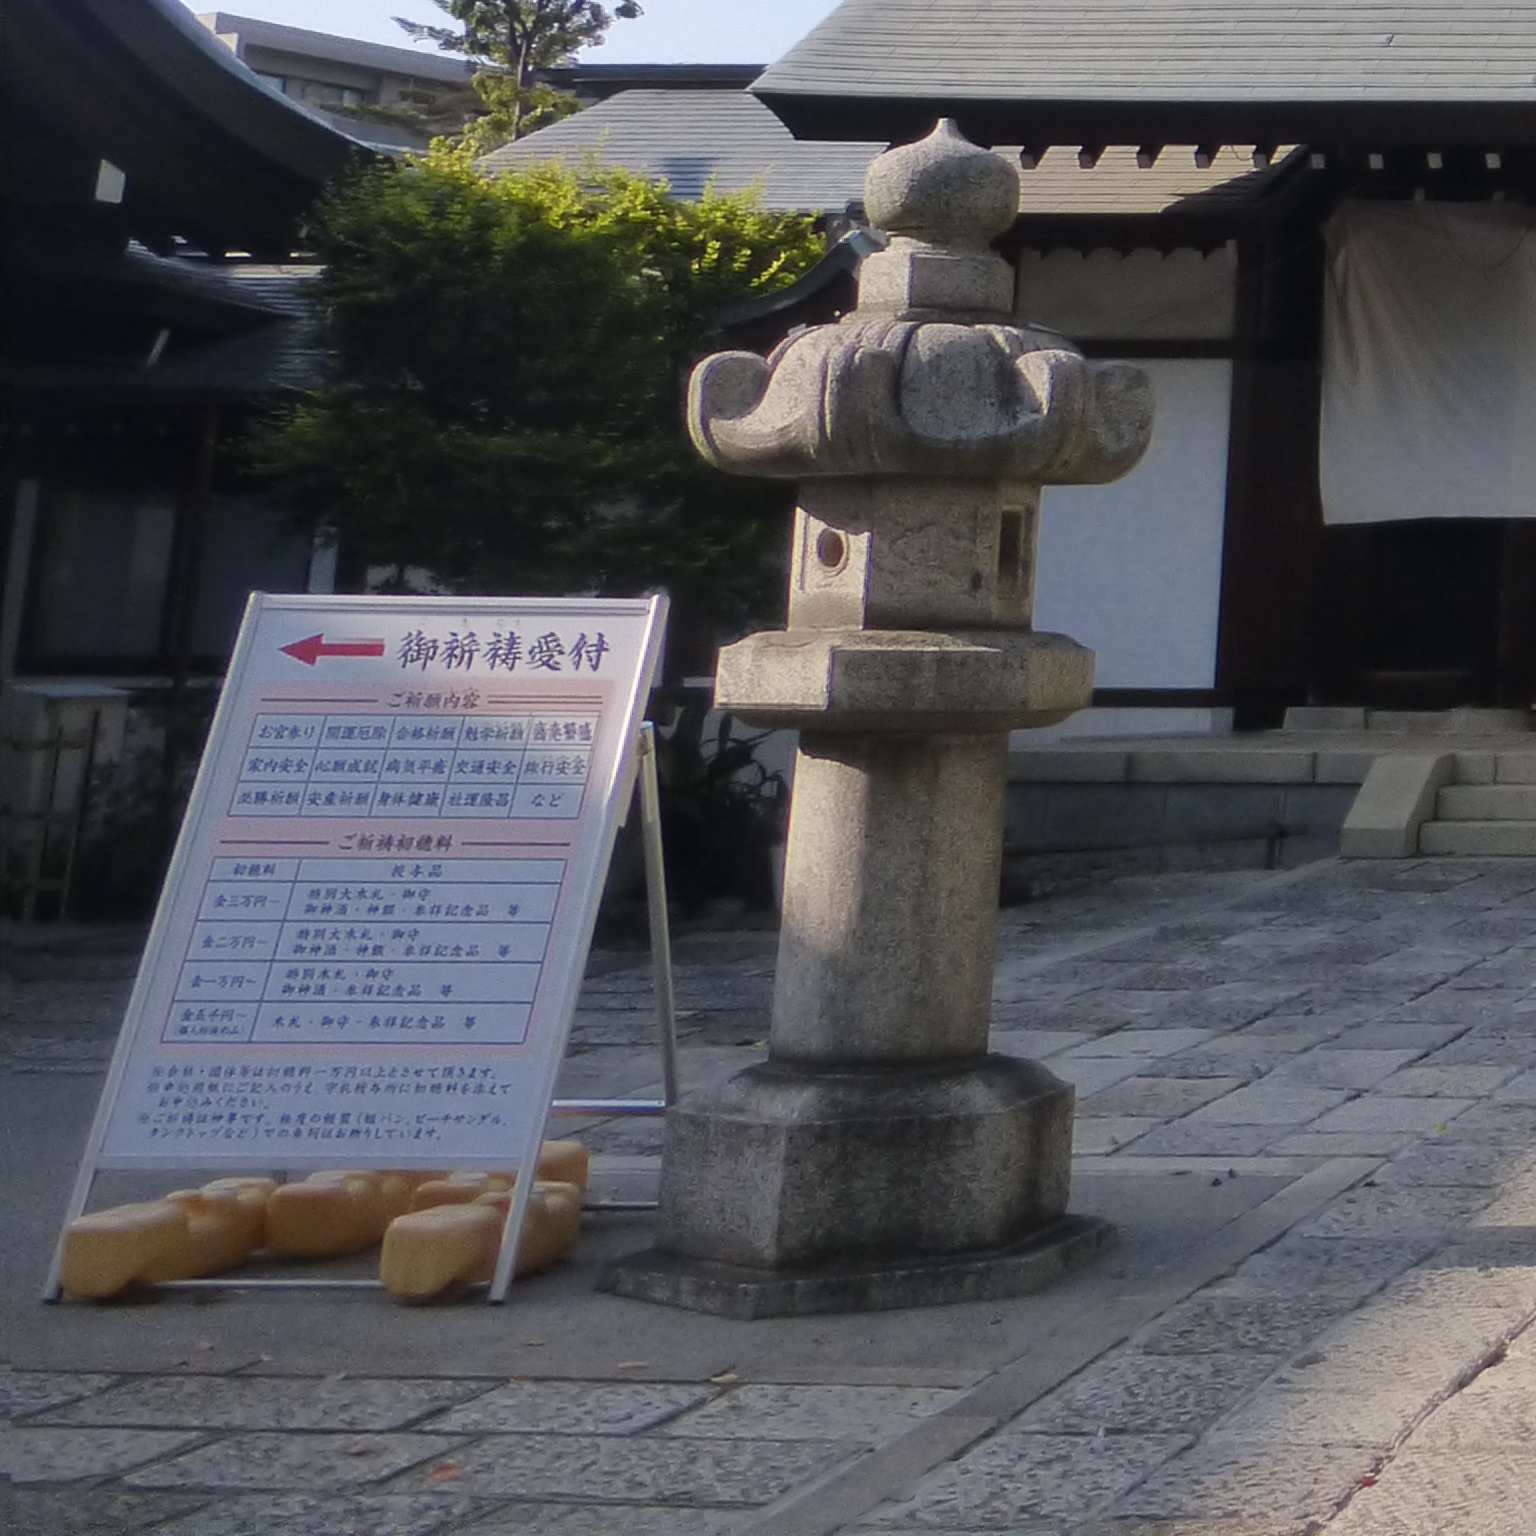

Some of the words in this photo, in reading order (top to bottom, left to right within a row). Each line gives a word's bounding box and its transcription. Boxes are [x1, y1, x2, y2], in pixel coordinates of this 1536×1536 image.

[396, 629, 610, 673] 御祈祷受付
[385, 691, 482, 711] ご祈願内容
[257, 723, 316, 740] お宮参り
[324, 724, 387, 741] 開運厄除
[396, 725, 457, 741] 合格祈願
[247, 757, 309, 774] 家内安全
[314, 758, 378, 774] 心願成就
[454, 759, 517, 775] 交通安全
[523, 756, 587, 775] 旅行安全
[237, 790, 300, 806] 必勝祈願
[306, 790, 371, 806] 安産祈願
[376, 791, 441, 807] 身体健康
[531, 792, 565, 808] など
[233, 862, 276, 877] 初穂料
[390, 863, 444, 878] 授与品
